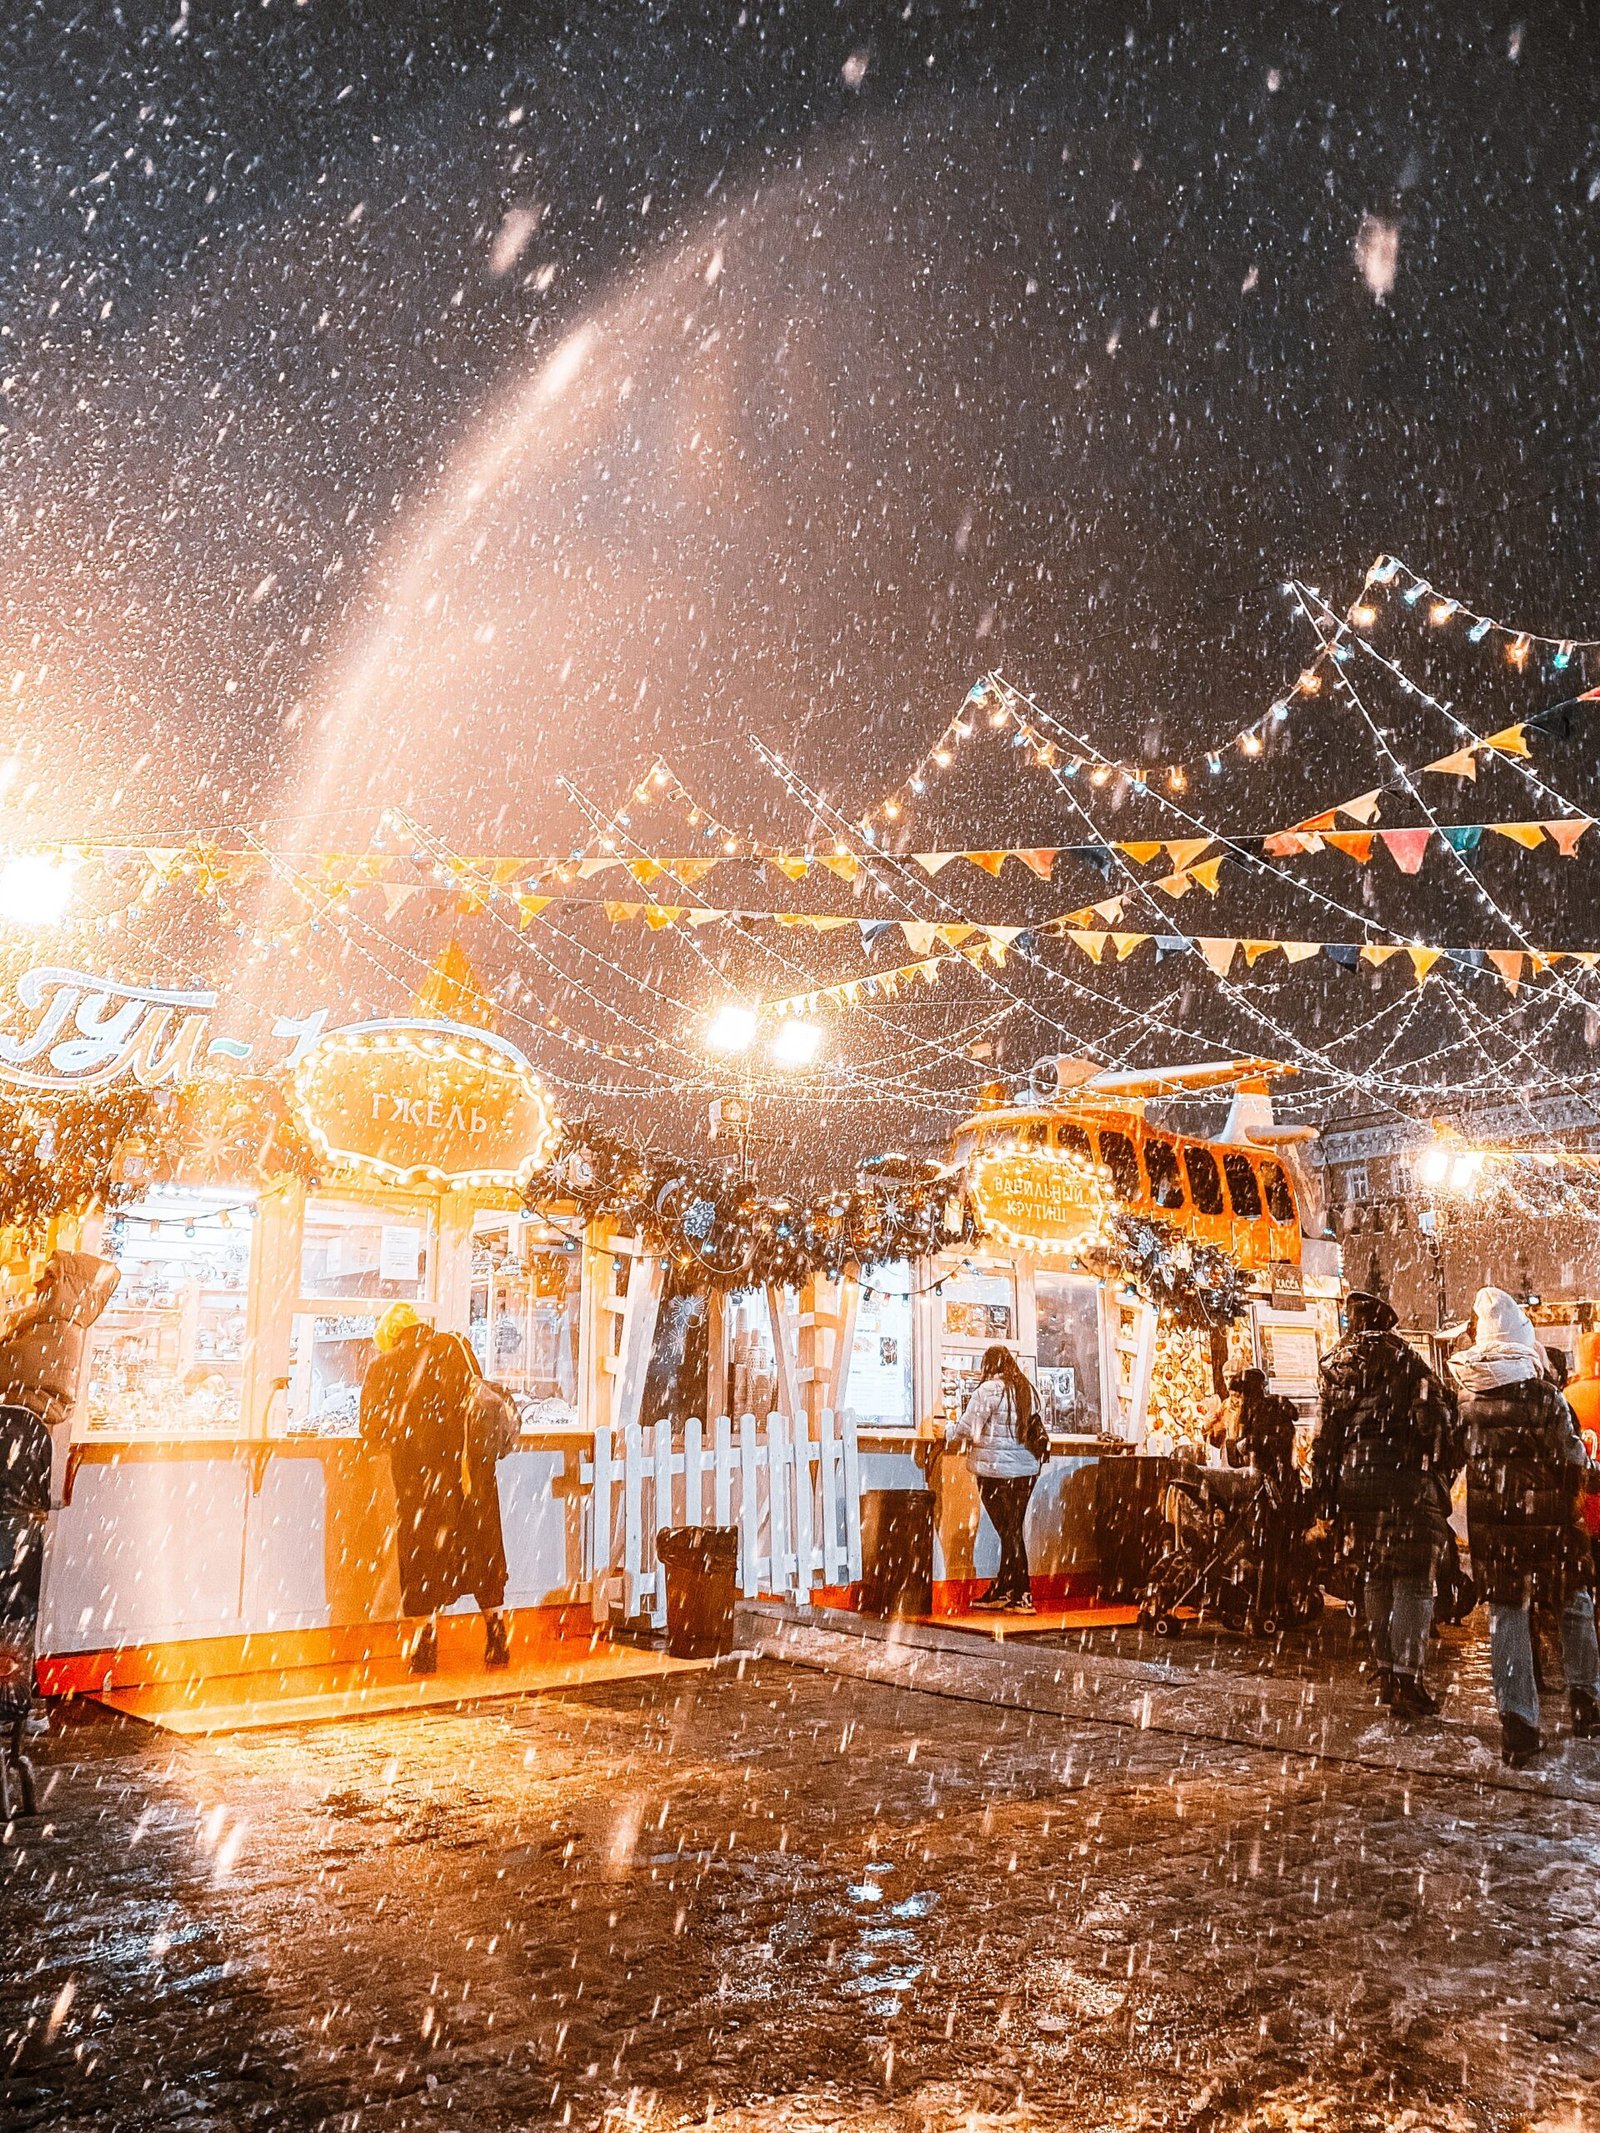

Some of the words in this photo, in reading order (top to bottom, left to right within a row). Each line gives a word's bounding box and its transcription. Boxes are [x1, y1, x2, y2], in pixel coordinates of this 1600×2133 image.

[372, 1092, 487, 1133] ГЖЕЛЬ
[994, 1176, 1083, 1203] ВАНИЛЬНЫЙ
[1007, 1200, 1066, 1223] КРУТИШ
[1275, 1278, 1300, 1290] КАССА
